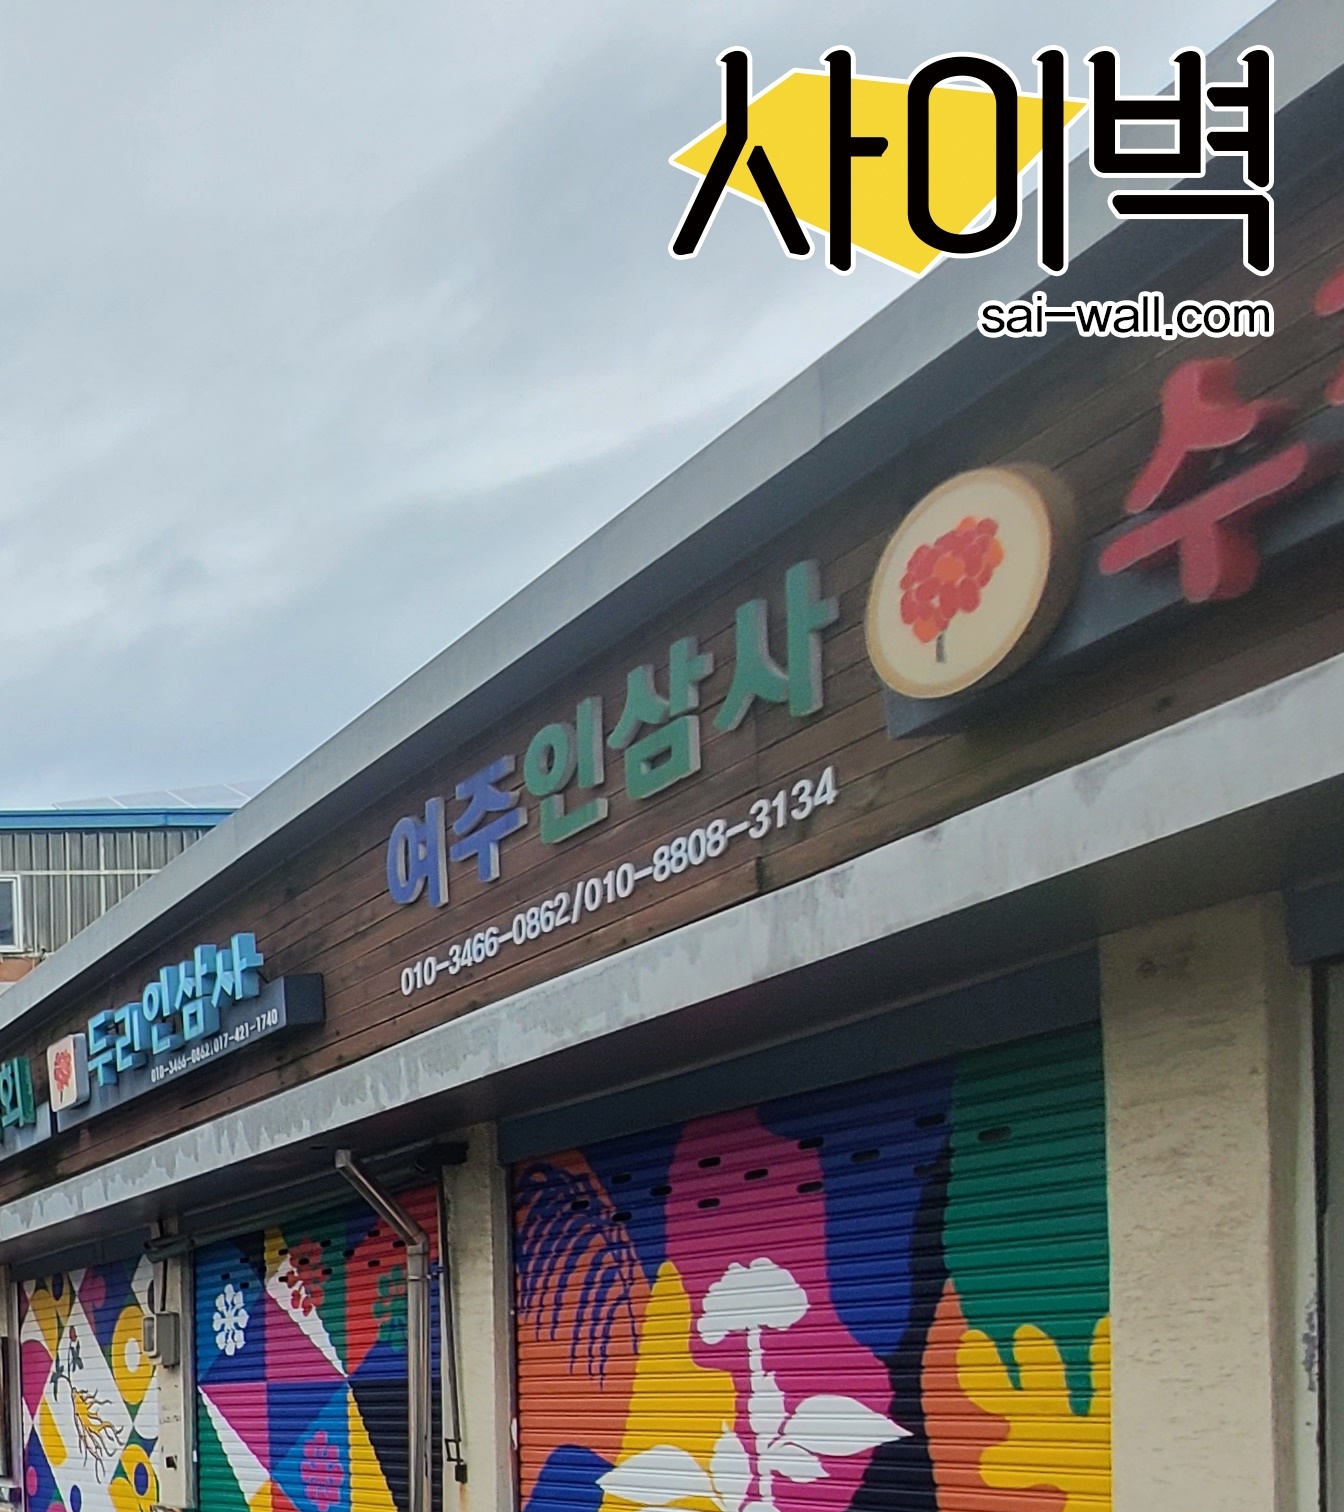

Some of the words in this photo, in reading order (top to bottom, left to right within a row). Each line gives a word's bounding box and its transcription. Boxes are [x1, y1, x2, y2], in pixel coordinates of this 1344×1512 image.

[1098, 262, 1344, 604] 수
[385, 558, 839, 909] 여주인삼사
[87, 932, 264, 1087] 두리인삼사
[400, 765, 840, 997] 010-3466-0862/010-8808-3134
